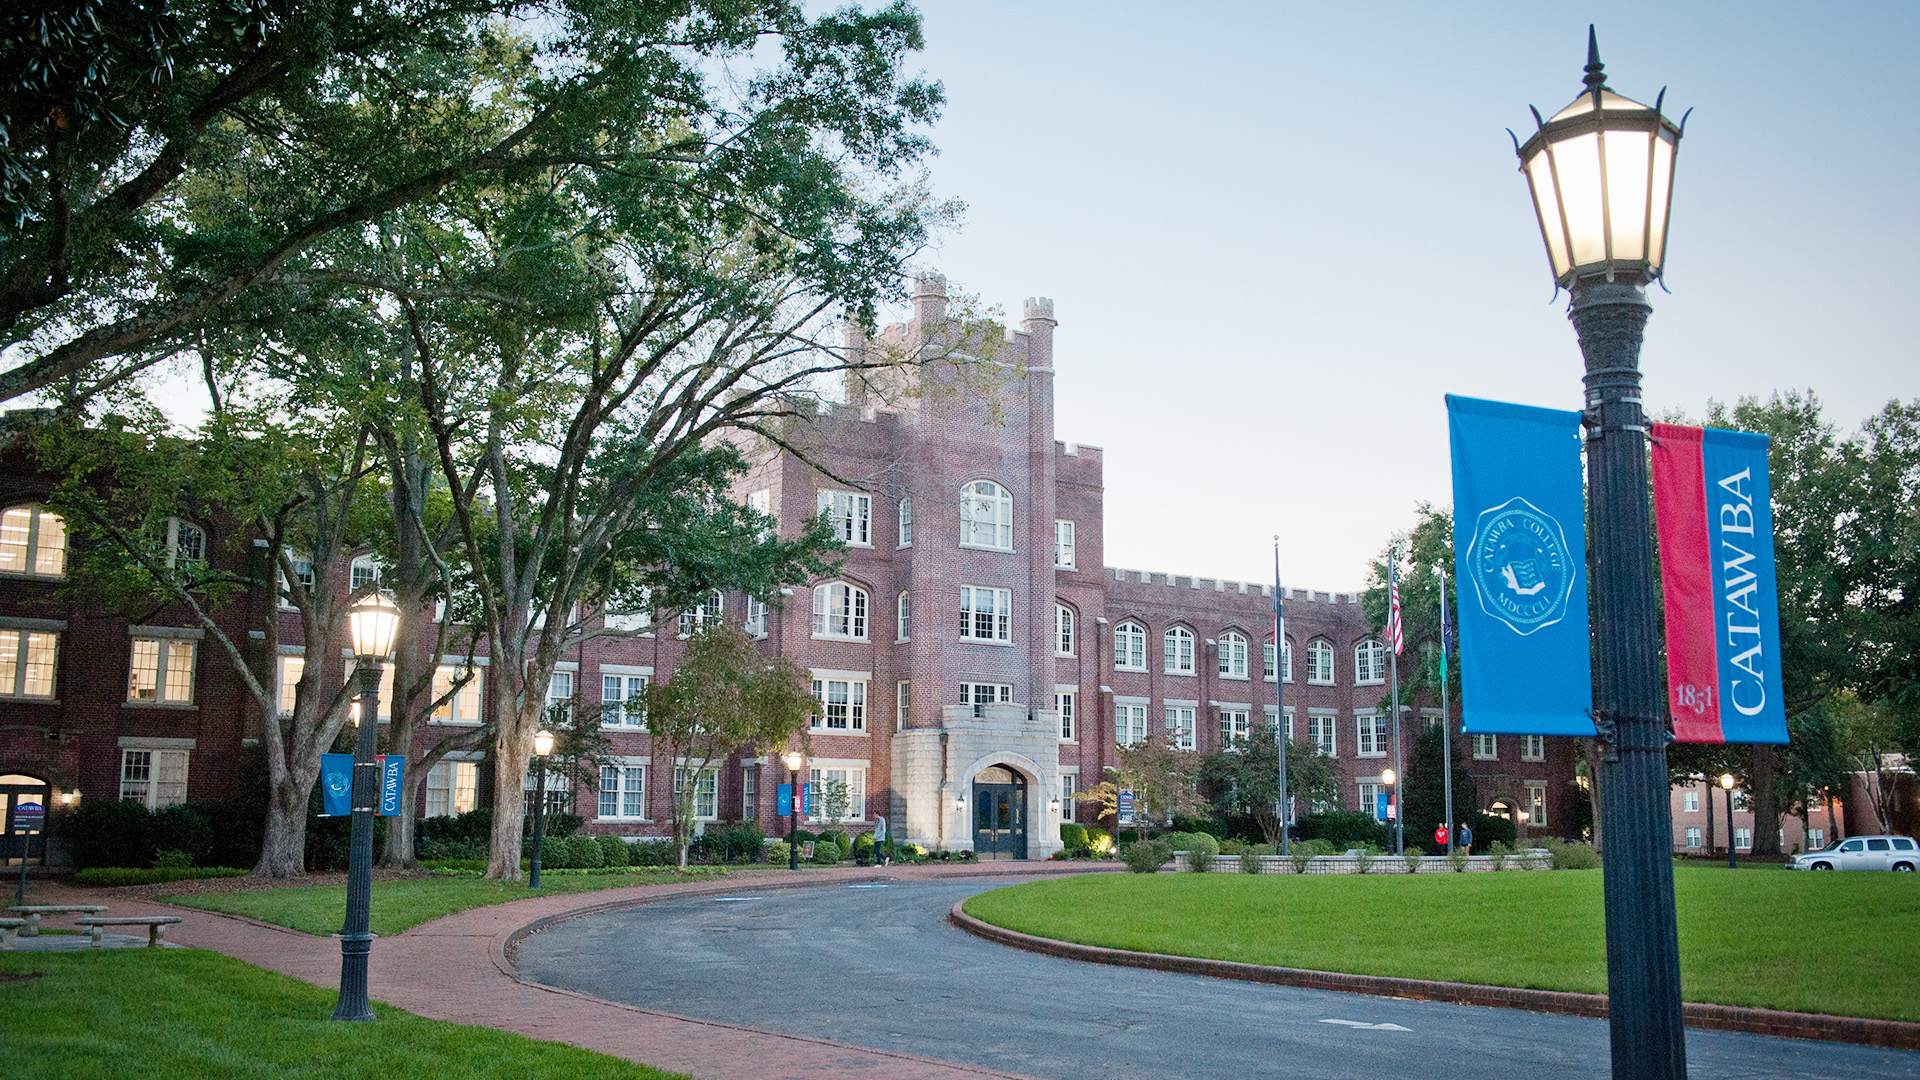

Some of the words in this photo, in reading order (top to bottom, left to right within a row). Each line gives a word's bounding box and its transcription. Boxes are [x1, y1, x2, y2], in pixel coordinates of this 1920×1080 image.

[1484, 518, 1515, 573] CATAWBA
[1523, 518, 1561, 571] COLLEGE
[1497, 592, 1551, 617] MDCCCLI
[1717, 466, 1766, 716] CATAWBA
[1675, 684, 1713, 714] 1851
[384, 761, 399, 812] CATAWBA
